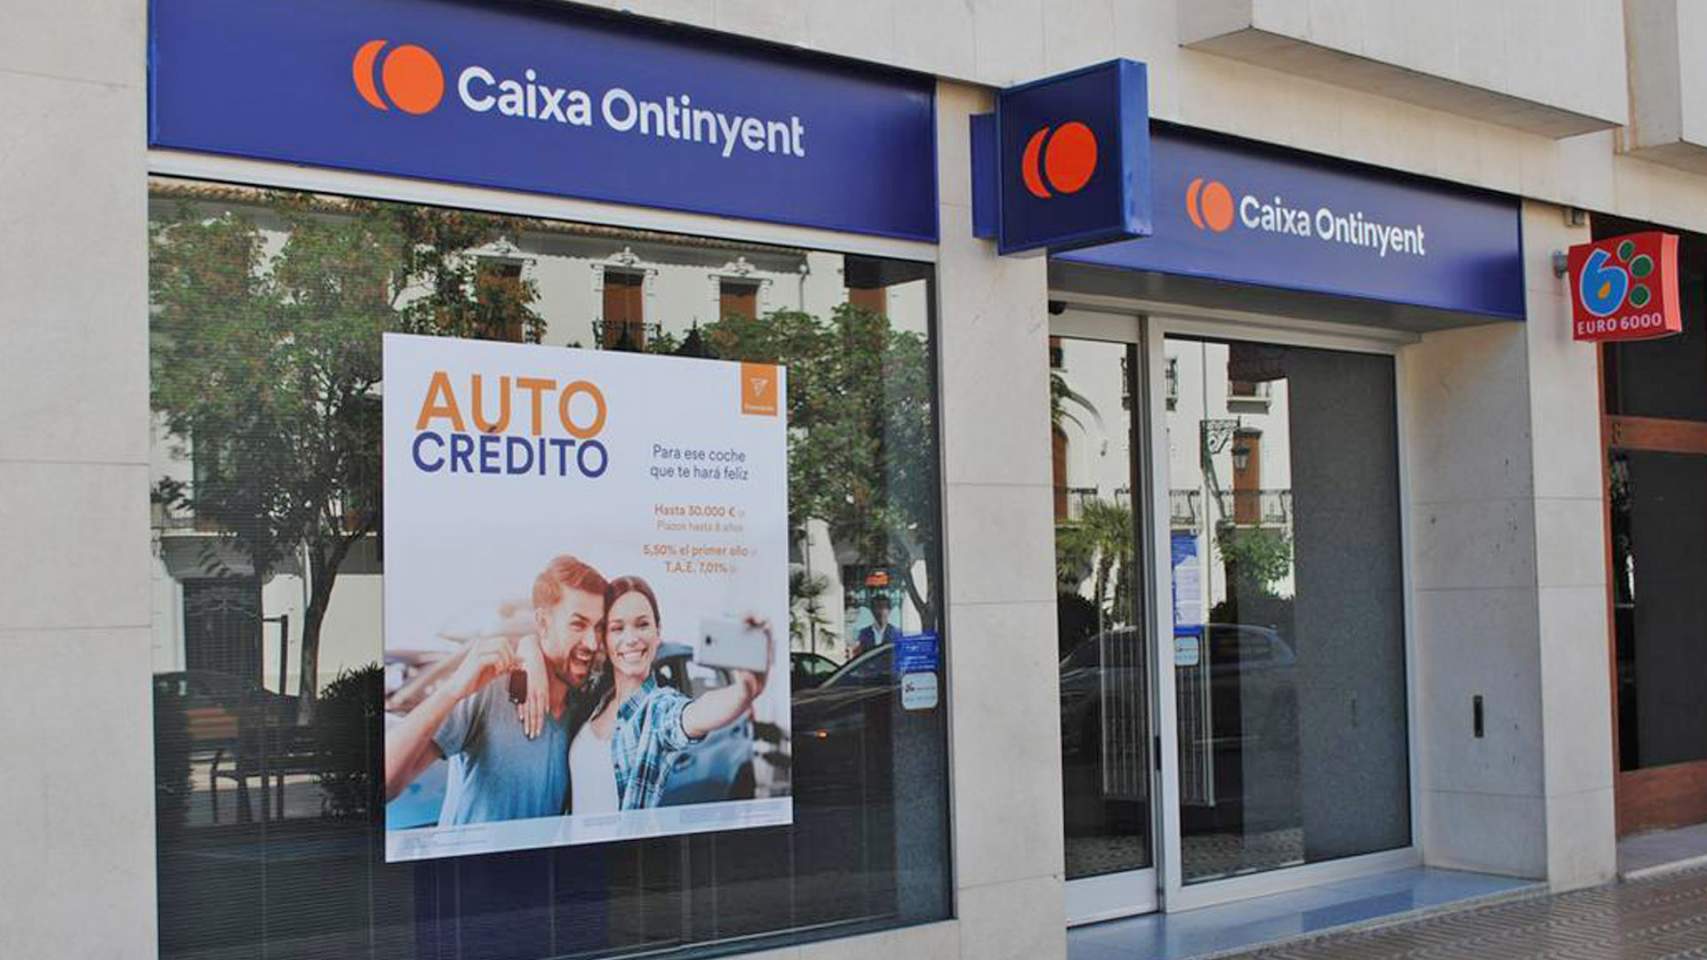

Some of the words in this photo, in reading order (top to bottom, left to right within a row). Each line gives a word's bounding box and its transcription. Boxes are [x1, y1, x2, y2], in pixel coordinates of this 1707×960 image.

[458, 66, 592, 126] Caixa
[602, 88, 805, 158] Ontinyent
[1240, 196, 1310, 237] Caixa
[1316, 208, 1425, 257] Ontinyent
[1577, 318, 1616, 335] EURO
[1620, 312, 1662, 329] 6000
[416, 371, 608, 439] AUTO
[412, 425, 609, 478] CRÉDITO
[653, 443, 681, 459] Para
[684, 449, 705, 460] ese
[709, 449, 746, 463] coche
[650, 466, 674, 480] que
[678, 466, 690, 478] te
[693, 465, 721, 480] hará
[723, 466, 748, 481] feliz
[654, 504, 686, 516] Hasta
[687, 505, 726, 517] 30.000
[680, 544, 689, 556] el
[666, 561, 696, 573] T.A.E.
